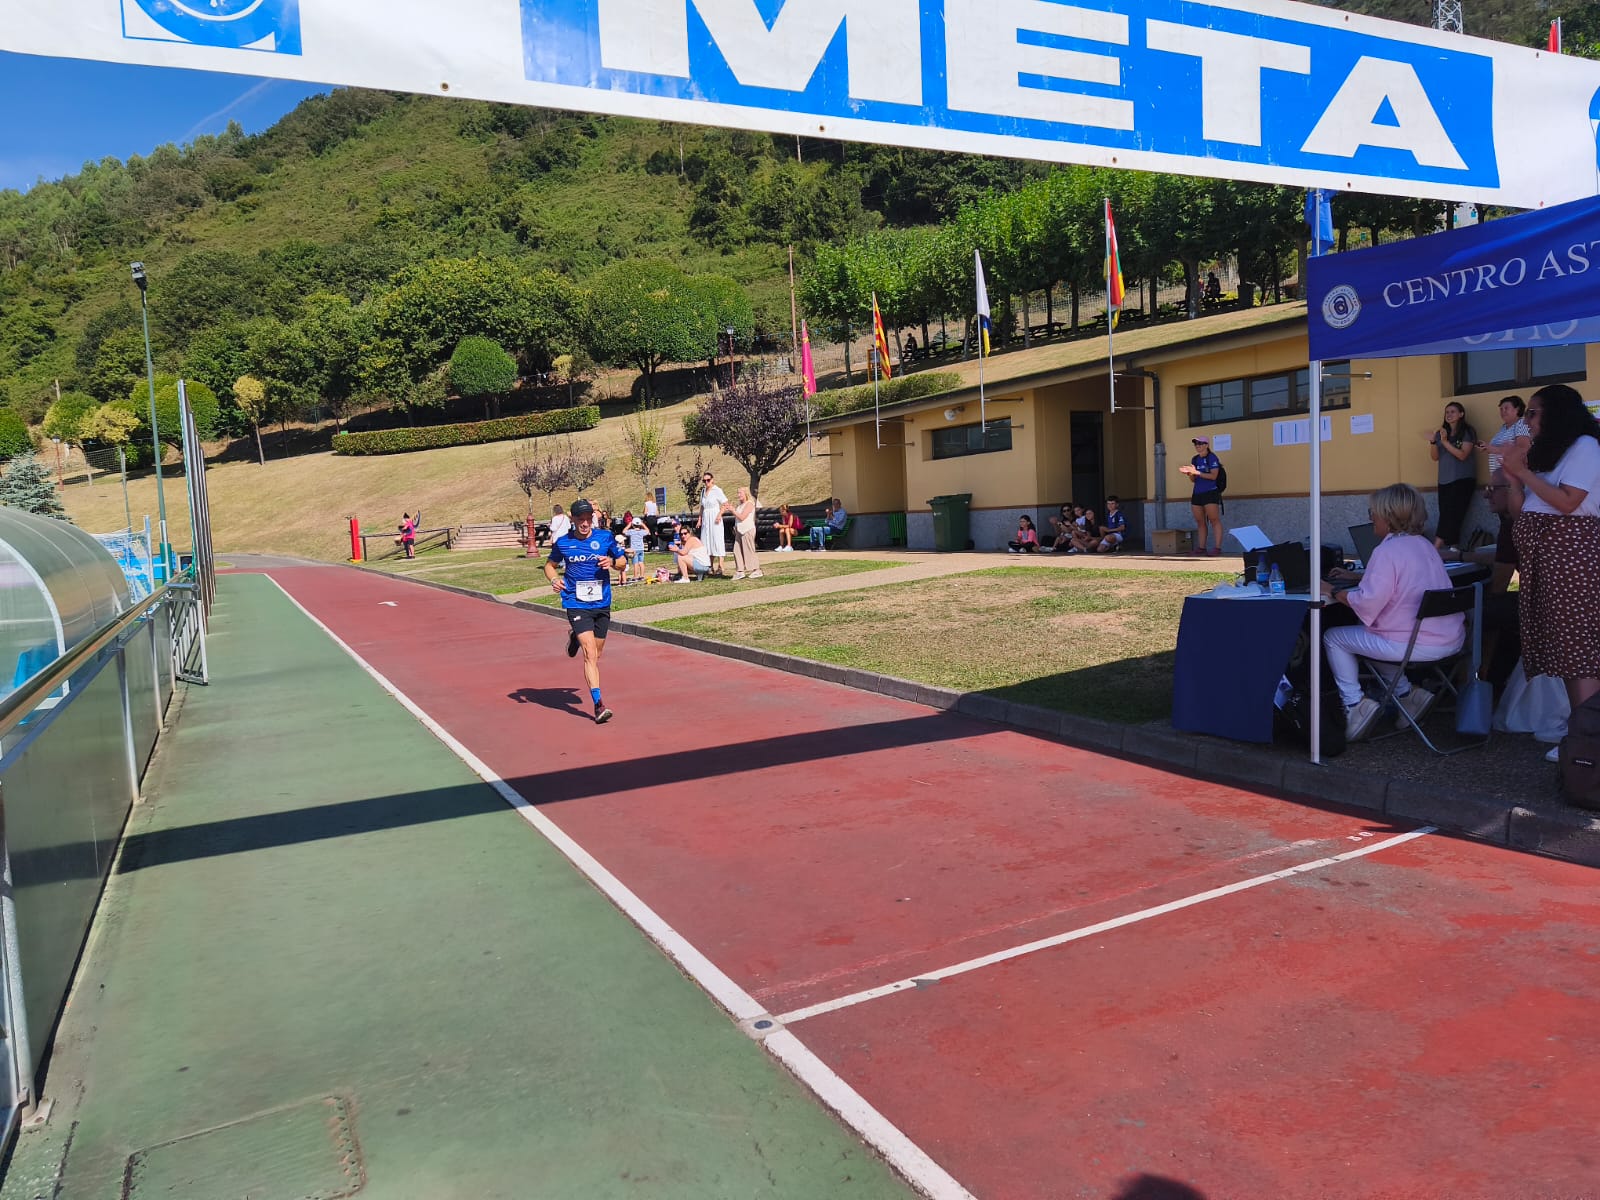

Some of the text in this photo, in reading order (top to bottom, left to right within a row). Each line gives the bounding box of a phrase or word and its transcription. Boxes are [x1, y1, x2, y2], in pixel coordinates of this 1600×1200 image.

[599, 0, 1469, 170] META
[1383, 257, 1526, 308] CENTRO
[587, 586, 594, 596] 2
